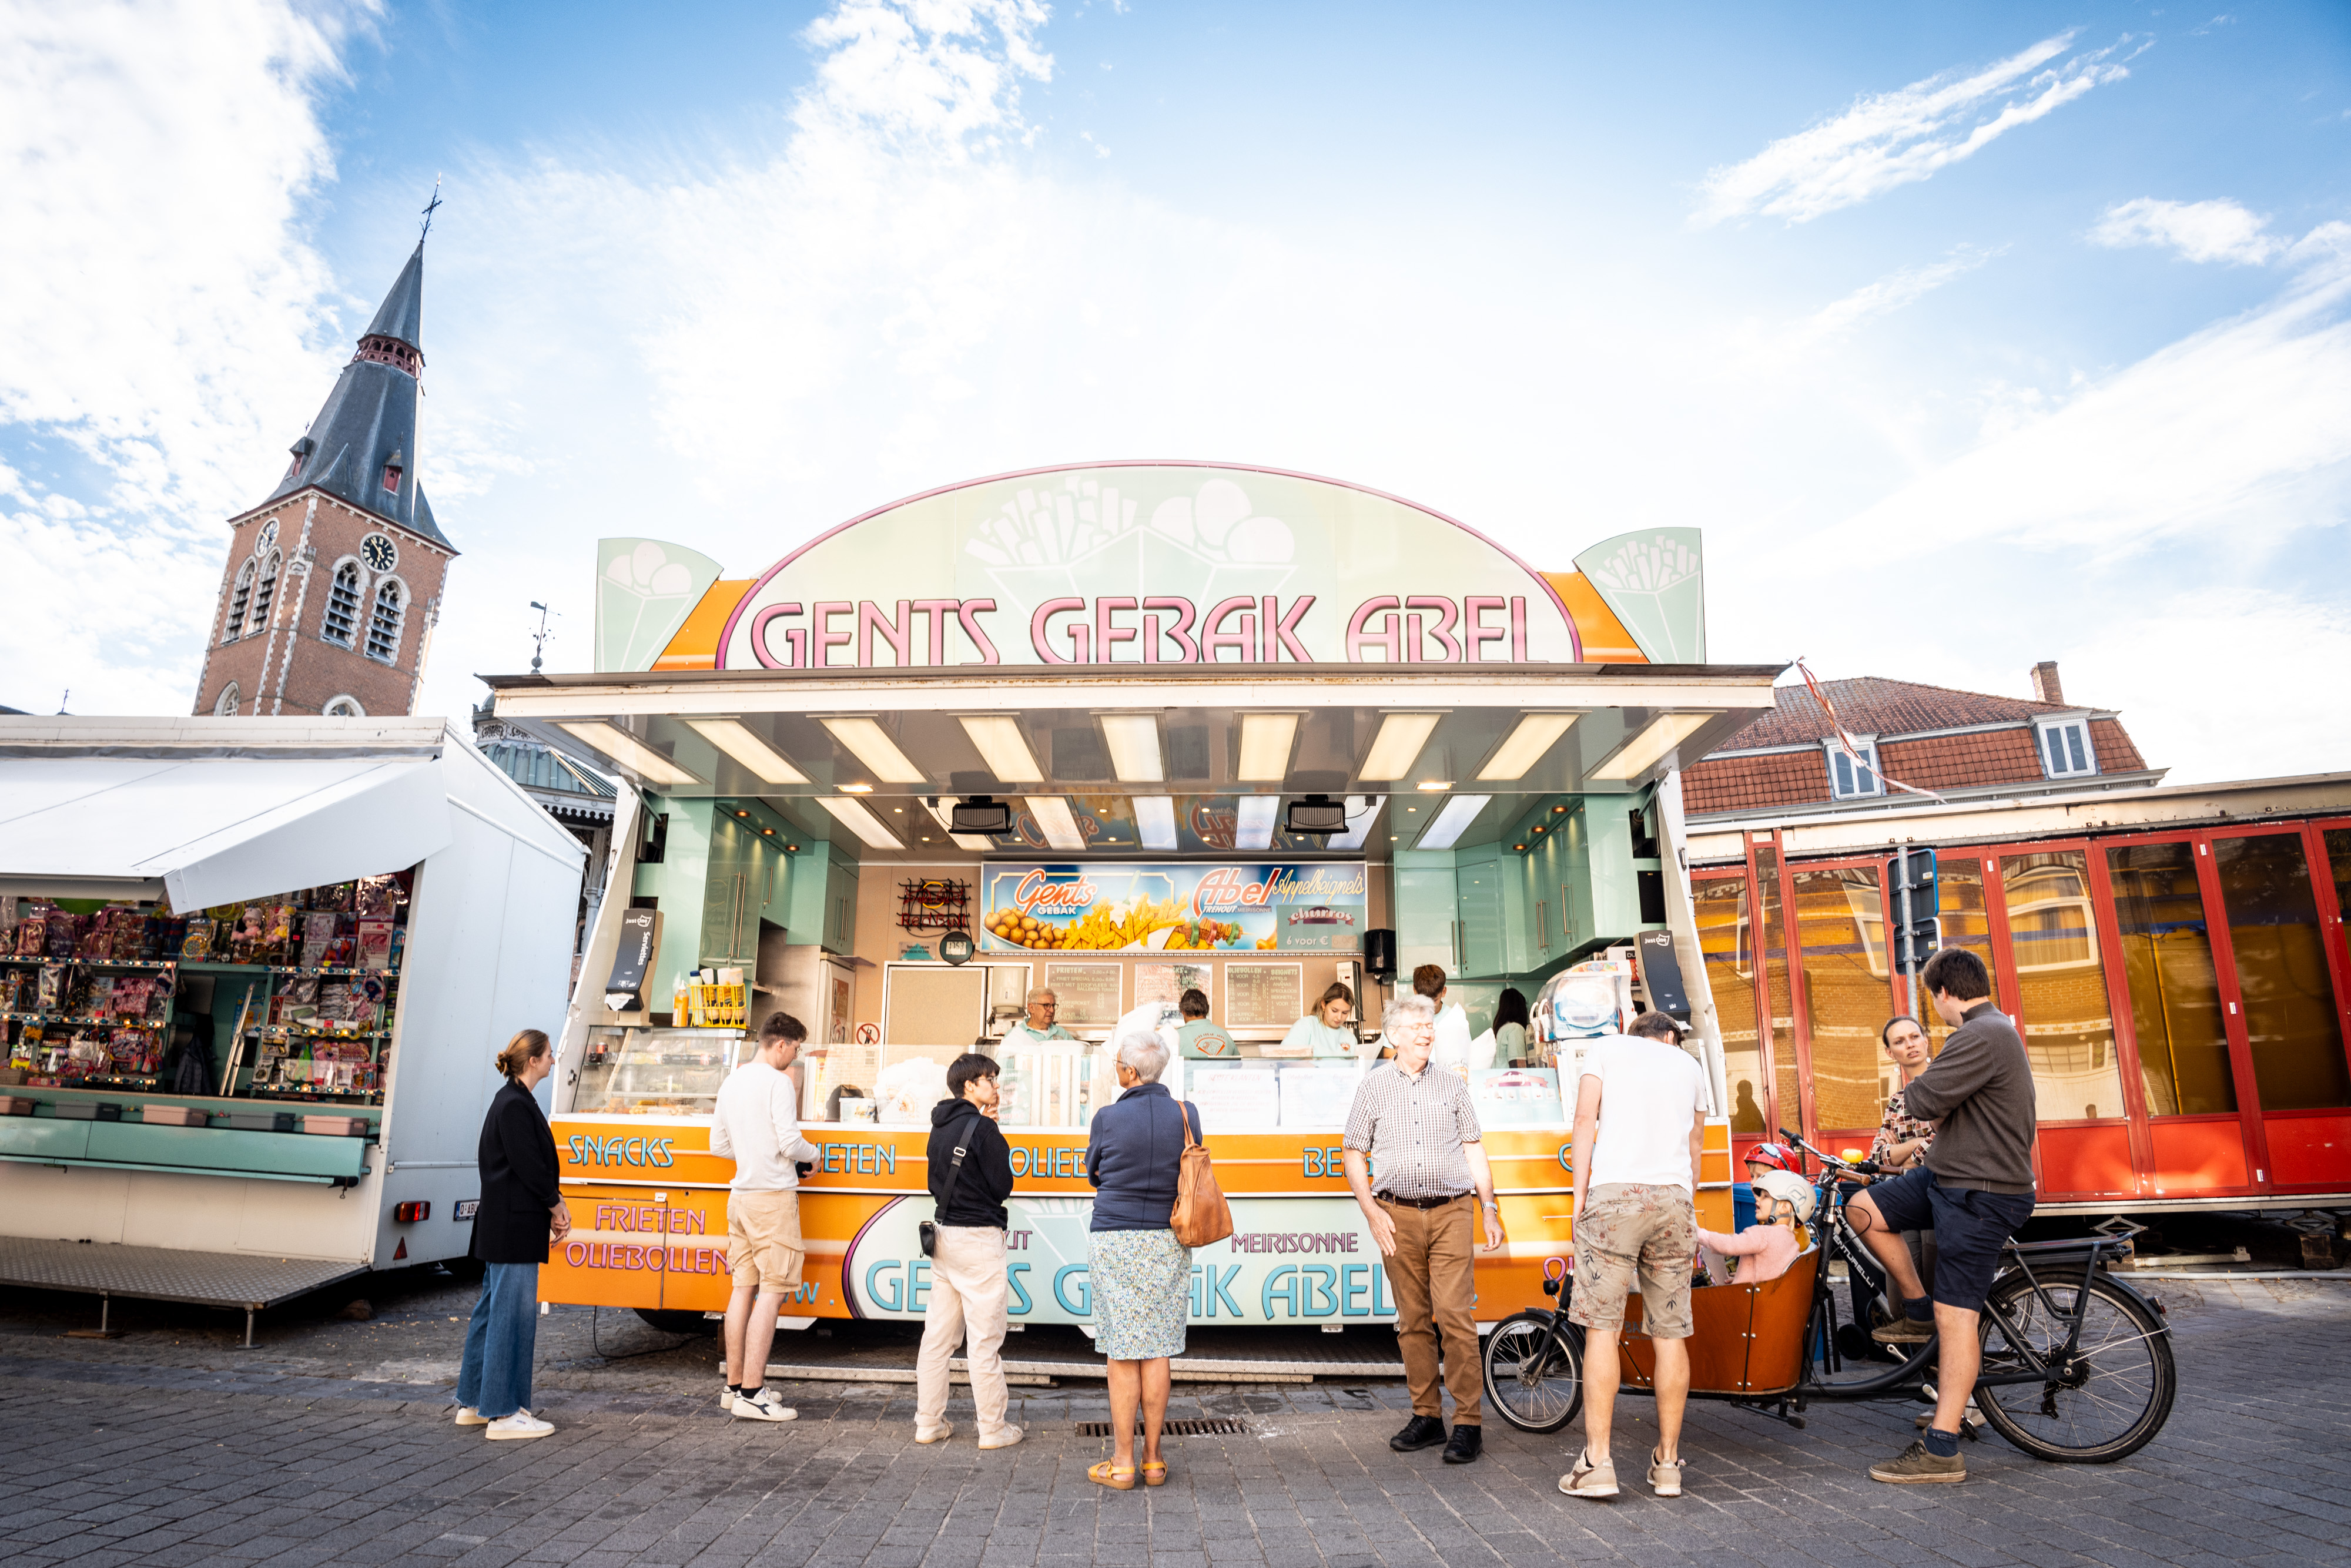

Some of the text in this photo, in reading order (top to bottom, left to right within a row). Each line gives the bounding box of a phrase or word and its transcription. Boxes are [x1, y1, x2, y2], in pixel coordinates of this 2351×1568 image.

[751, 595, 1549, 669] GENTS GEBAK ABEL
[1014, 868, 1098, 916] Gents
[1192, 867, 1282, 920] Abel
[1272, 869, 1364, 906] Appelbeignets
[1291, 907, 1352, 921] churros
[638, 931, 651, 966] Serviettes
[1287, 936, 1292, 945] 6
[1319, 936, 1328, 945] €
[568, 1134, 674, 1168] SNACKS
[813, 1142, 895, 1176] IETEN
[595, 1205, 705, 1235] FRIETEN
[565, 1241, 731, 1276] OLIEBOLLEN
[1231, 1233, 1358, 1254] MEIRISONNE
[1833, 1231, 1874, 1288] ENTURELLI
[1262, 1264, 1397, 1320] ABEL
